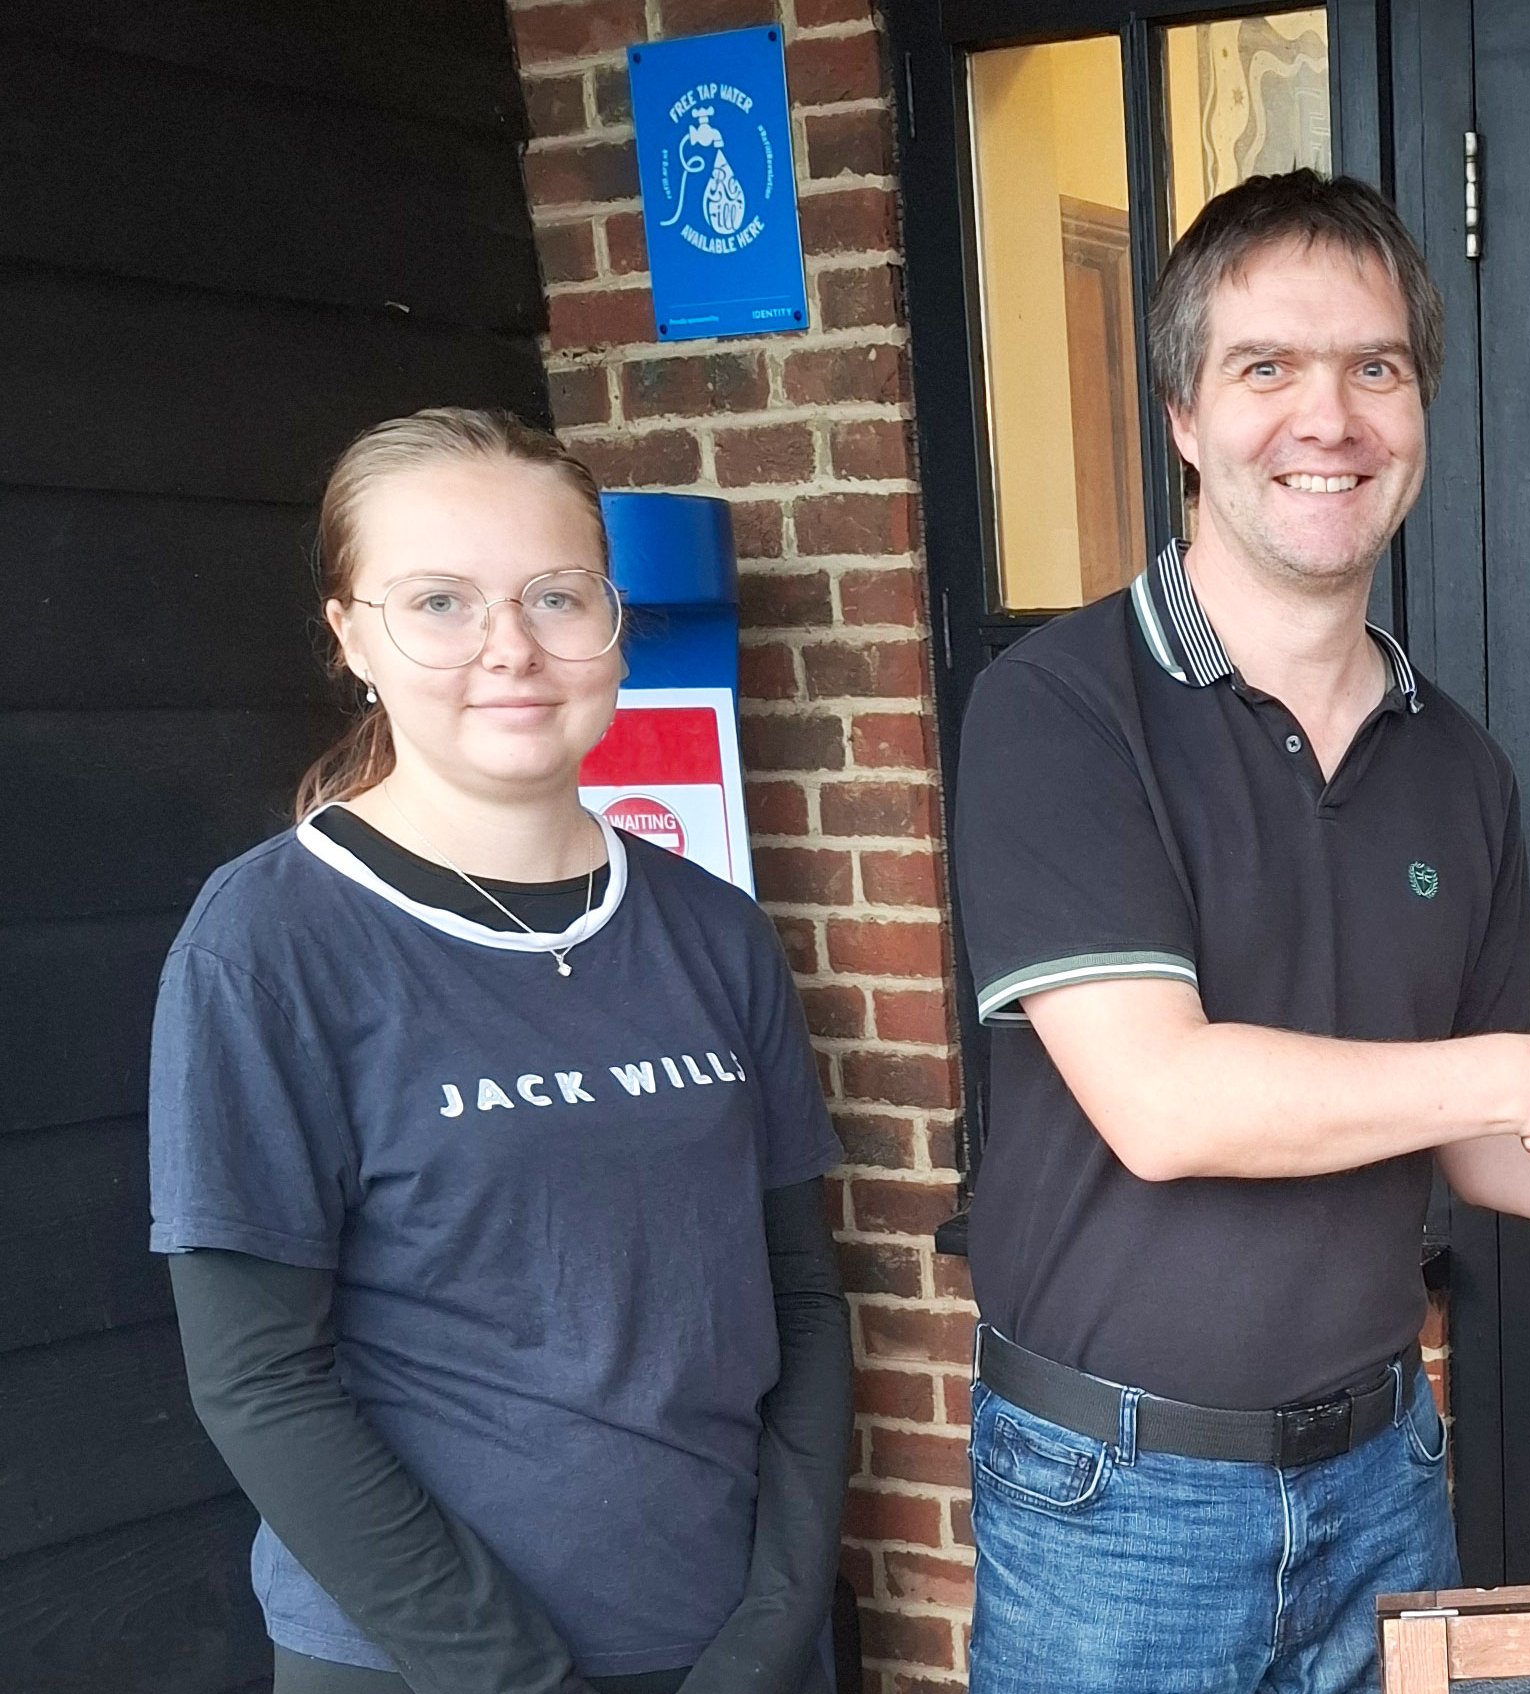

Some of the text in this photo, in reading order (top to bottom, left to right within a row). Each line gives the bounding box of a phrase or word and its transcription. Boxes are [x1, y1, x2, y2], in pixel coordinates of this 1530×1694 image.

[669, 83, 753, 124] FREE TAP WATER
[680, 215, 765, 255] AVAILABLE HERE
[752, 307, 792, 320] IDENTITY
[600, 813, 677, 832] WAITING
[440, 1071, 596, 1118] JACK
